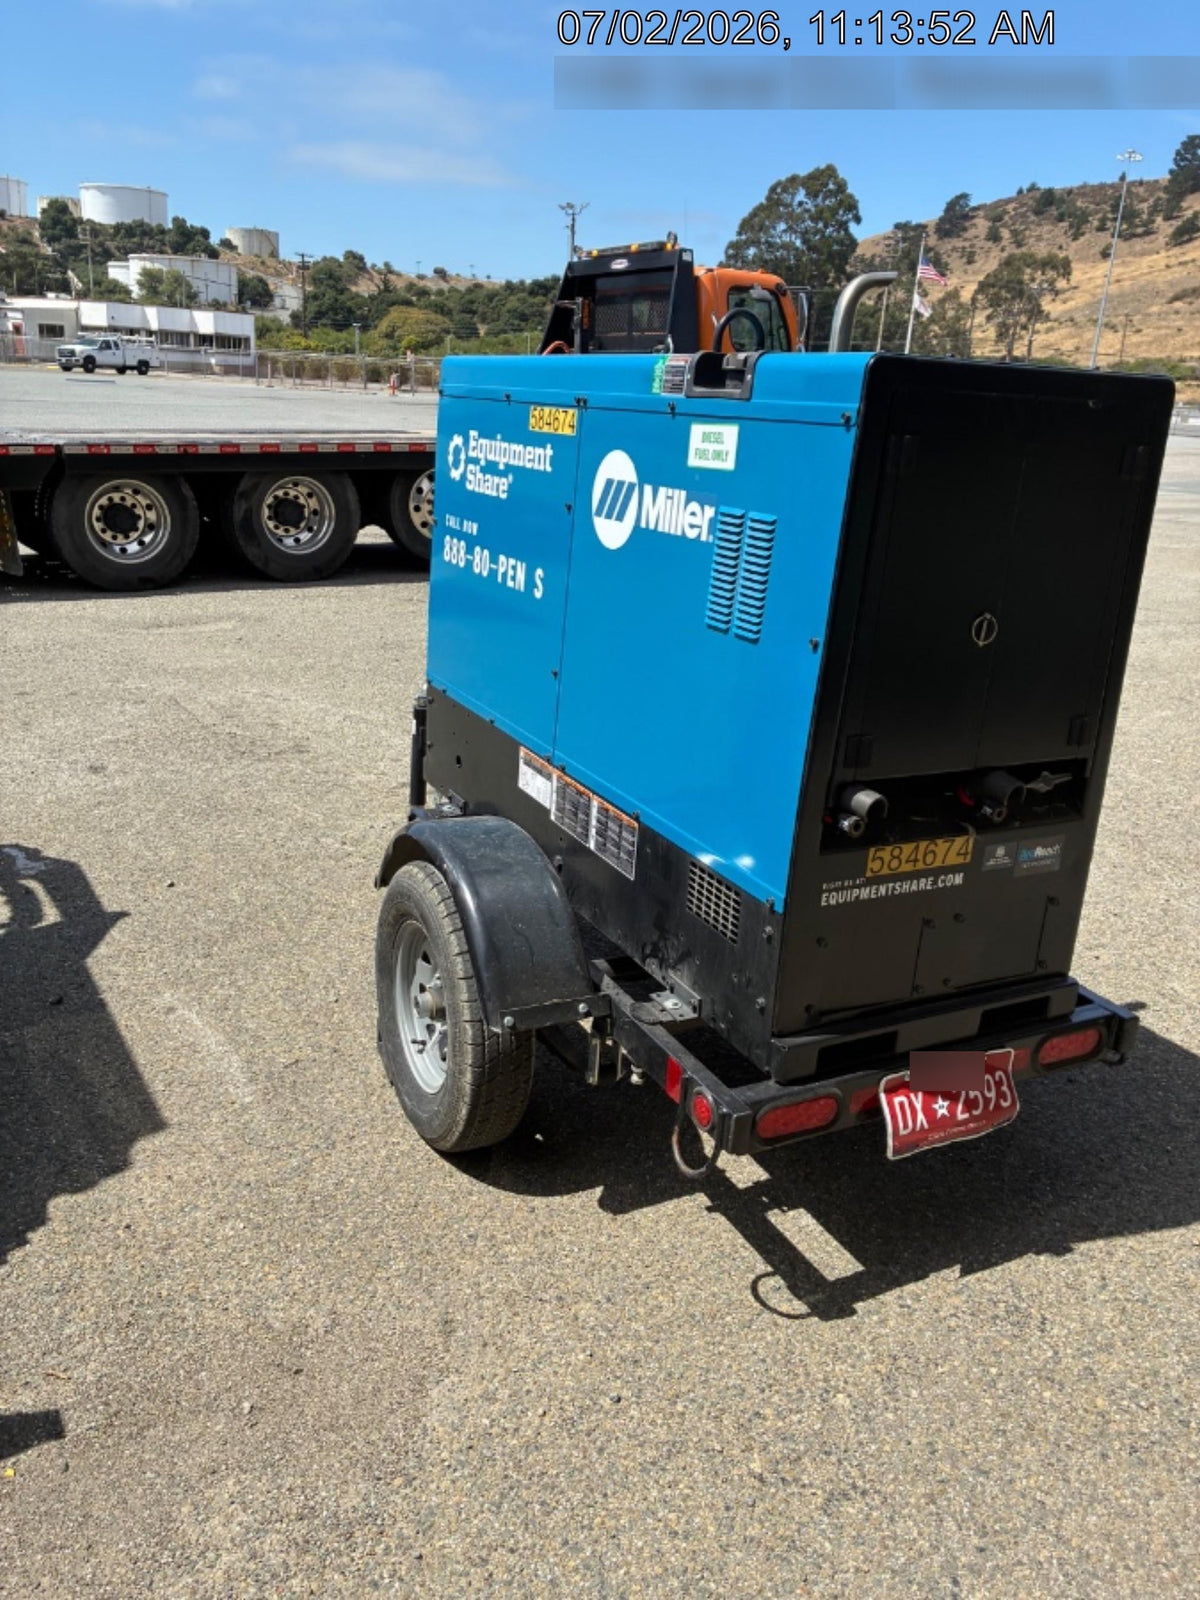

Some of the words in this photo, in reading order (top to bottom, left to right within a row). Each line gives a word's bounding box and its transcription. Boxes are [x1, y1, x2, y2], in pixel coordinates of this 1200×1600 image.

[530, 406, 576, 434] 584674
[468, 429, 554, 472] Equipment
[869, 836, 971, 875] 584674
[820, 872, 965, 906] EQUIPMENTSHARE.COM
[893, 1091, 929, 1136] DX
